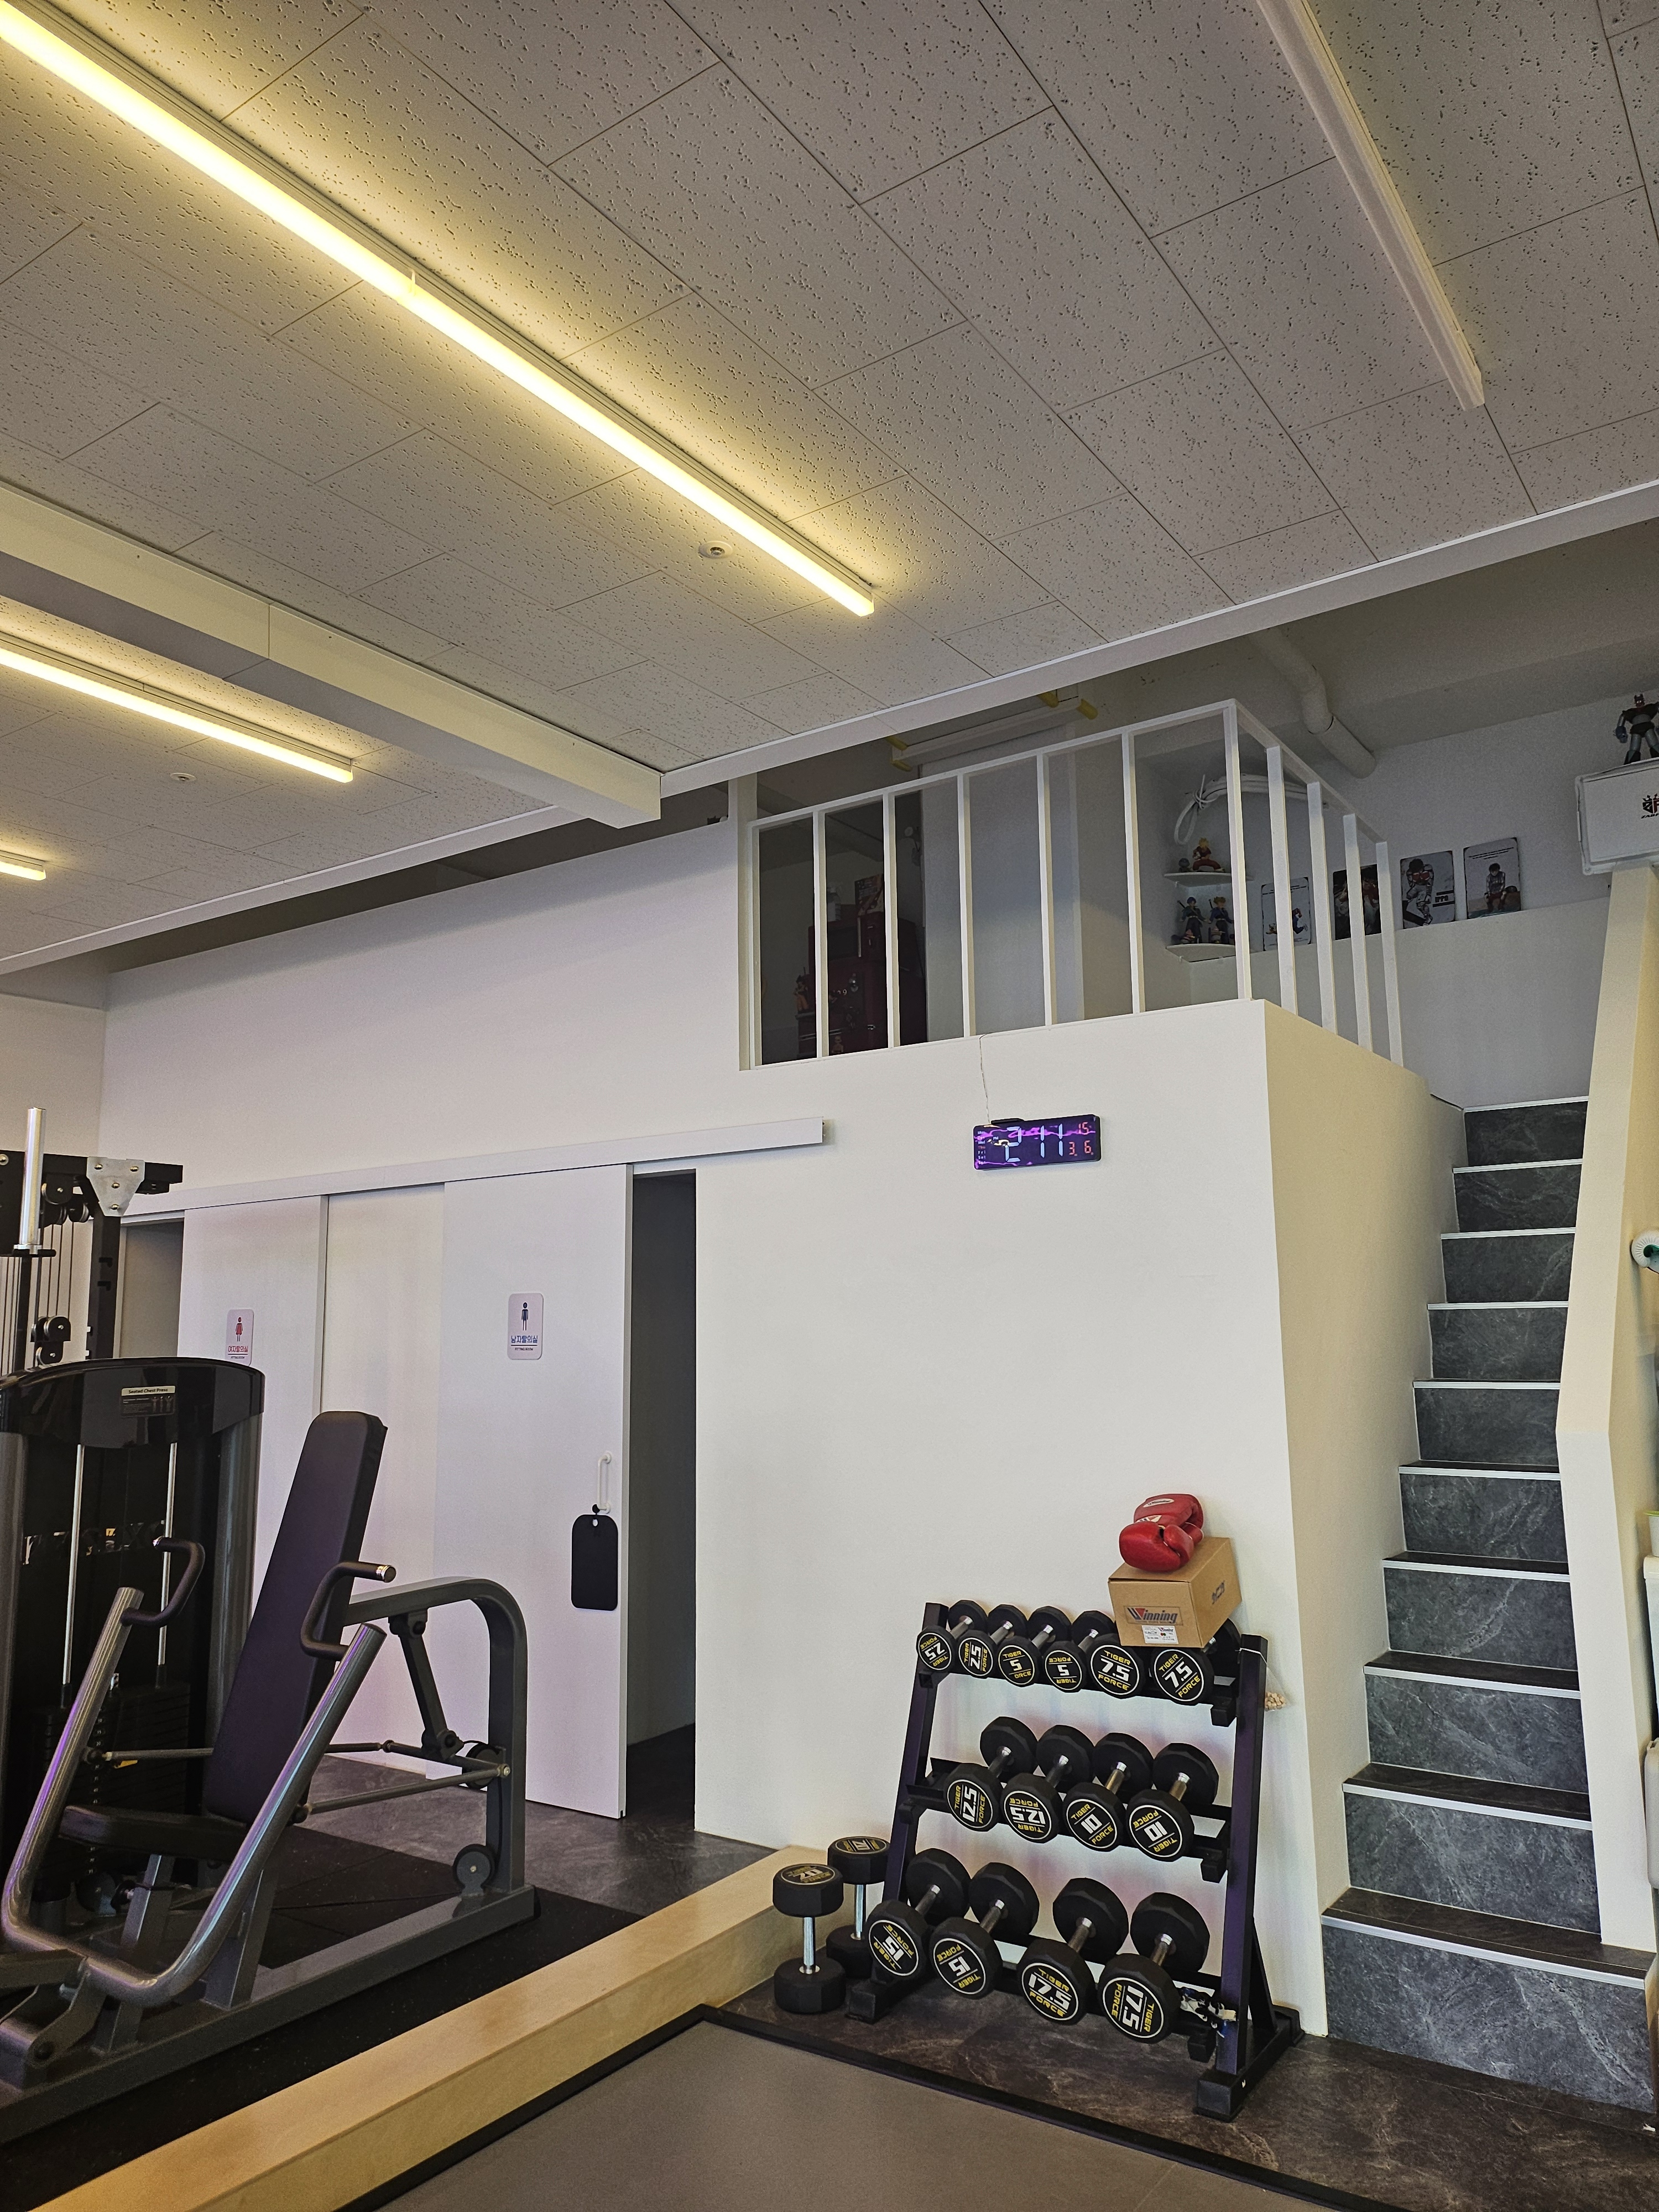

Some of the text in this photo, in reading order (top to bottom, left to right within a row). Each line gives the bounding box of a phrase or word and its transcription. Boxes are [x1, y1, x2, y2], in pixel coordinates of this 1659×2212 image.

[920, 1636, 937, 1650] FORCE
[925, 1642, 945, 1660] 2.5
[932, 1656, 948, 1667] TIGER
[971, 1644, 981, 1670] 2.5
[1009, 1659, 1022, 1671] 5
[1104, 1650, 1131, 1666] TIGER
[1159, 1653, 1179, 1672] TIGER
[1057, 1665, 1070, 1676] 5
[1100, 1658, 1130, 1681] 7.5
[1165, 1661, 1193, 1688] 7.5
[1098, 1674, 1130, 1691] FORCE
[1178, 1675, 1201, 1698] FORCE
[963, 1786, 977, 1822] 12.5
[1010, 1798, 1039, 1807] FORCE
[1071, 1804, 1091, 1820] TIGER
[1010, 1807, 1046, 1824] 12.5
[1081, 1814, 1103, 1834] 10
[1133, 1809, 1159, 1828] FORCE
[1018, 1824, 1044, 1833] TIGER
[1092, 1825, 1114, 1844] FORCE
[1144, 1821, 1168, 1841] 10
[1153, 1837, 1178, 1852] TIGER
[883, 1936, 904, 1961] 15
[885, 1924, 914, 1956] FORCE
[874, 1942, 896, 1970] TIGER
[937, 1944, 962, 1961] FORCE
[948, 1956, 971, 1976] 15
[958, 1973, 981, 1989] TIGER
[1039, 1968, 1070, 1992] TIGER
[1029, 1973, 1071, 2010] 17.5
[1112, 1983, 1123, 2018] FORCE
[1030, 1991, 1066, 2017] FORCE
[1123, 1985, 1144, 2031] 17.5
[1144, 2003, 1155, 2032] TIGER
